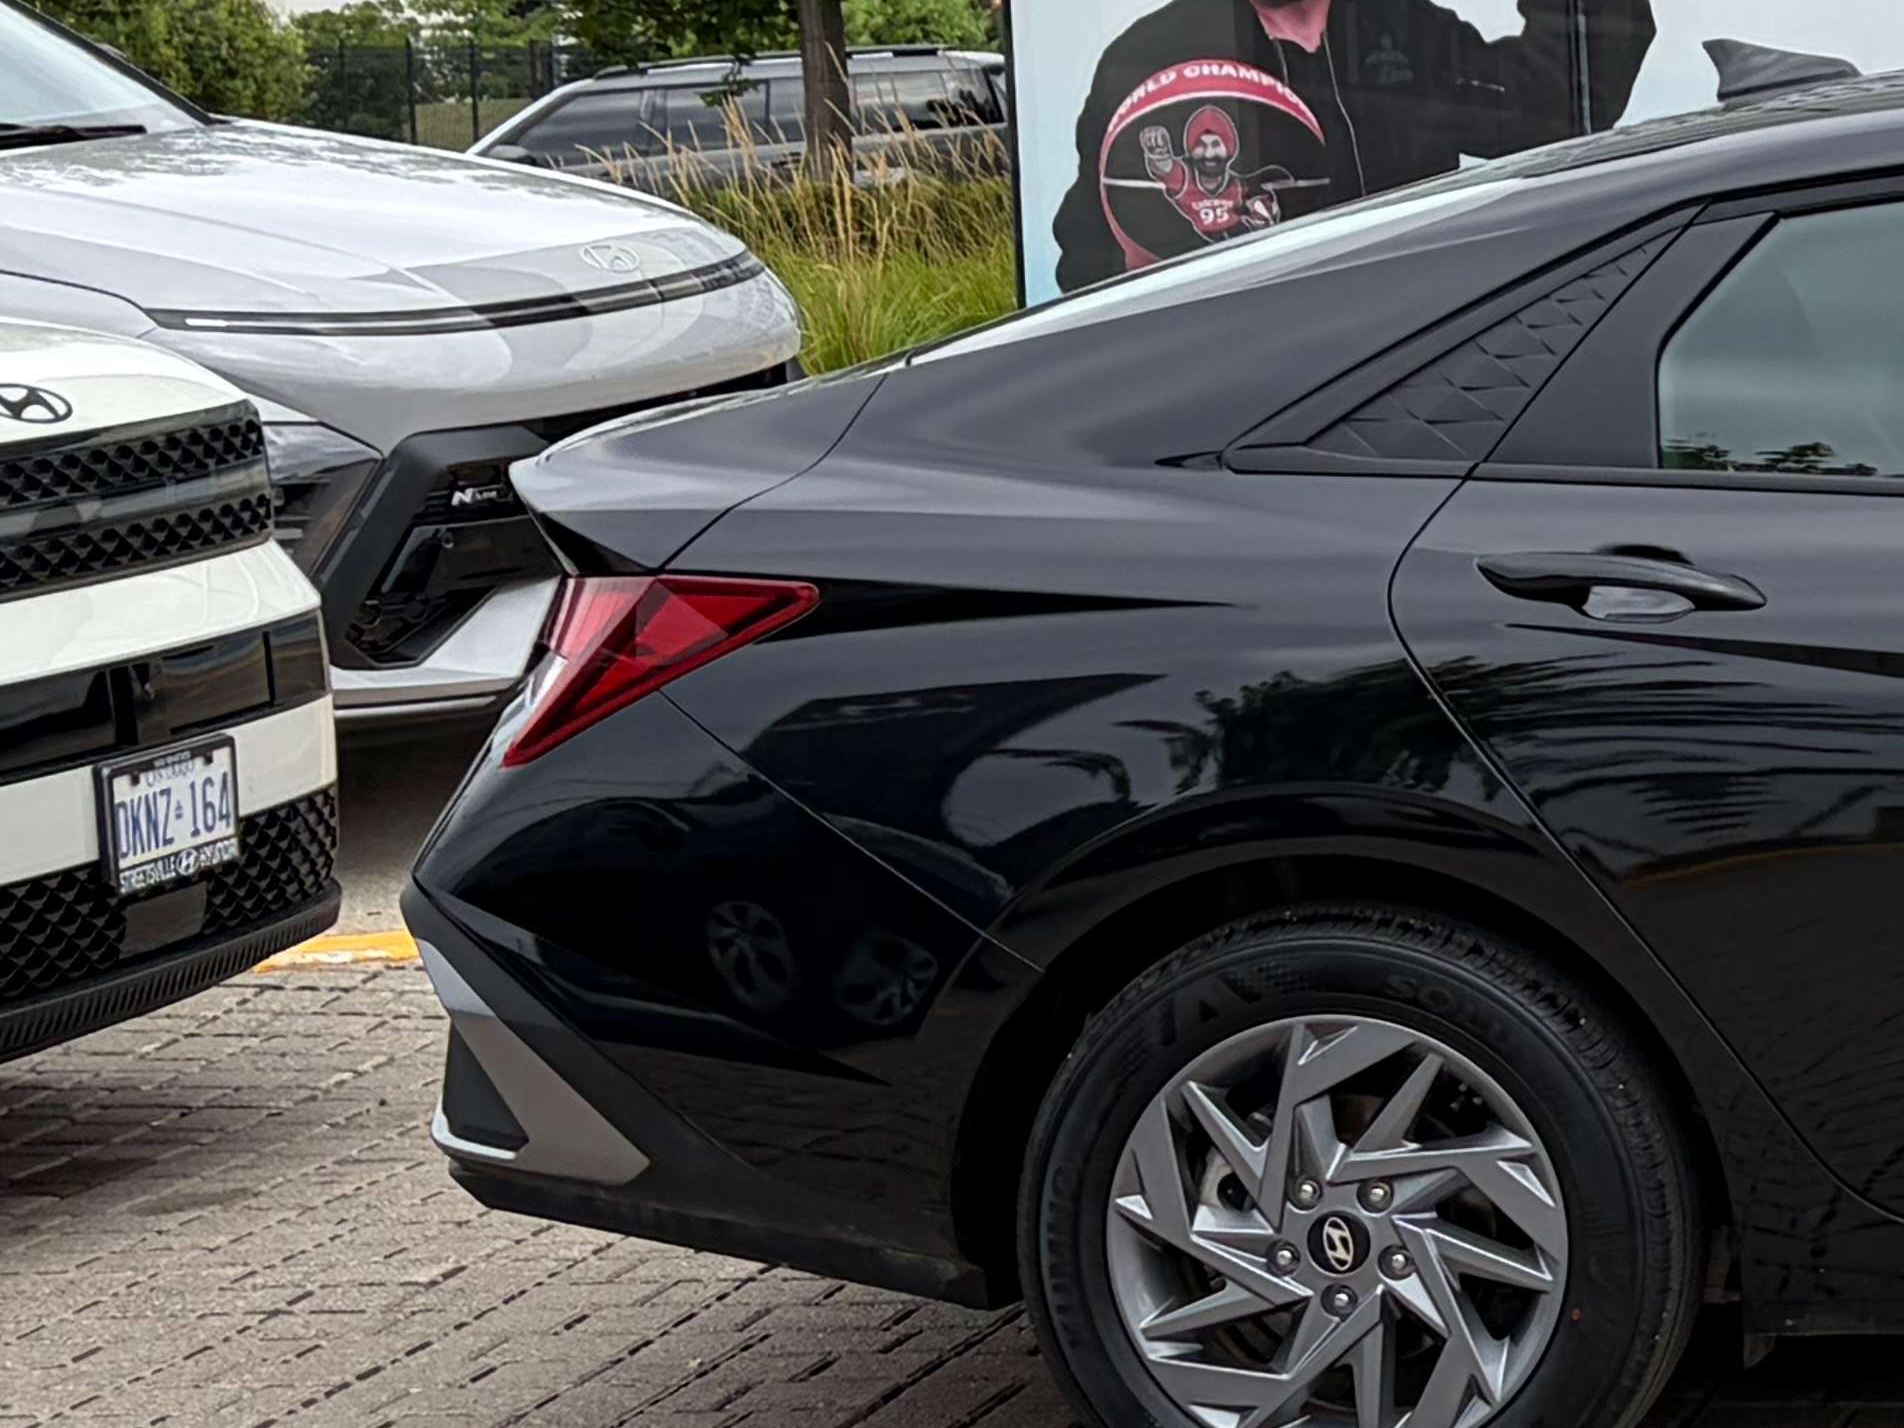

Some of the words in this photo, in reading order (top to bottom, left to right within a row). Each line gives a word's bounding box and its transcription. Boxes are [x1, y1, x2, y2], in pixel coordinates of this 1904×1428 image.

[1200, 208, 1229, 224] 95
[115, 786, 175, 859] DKNZ
[189, 771, 231, 838] 164
